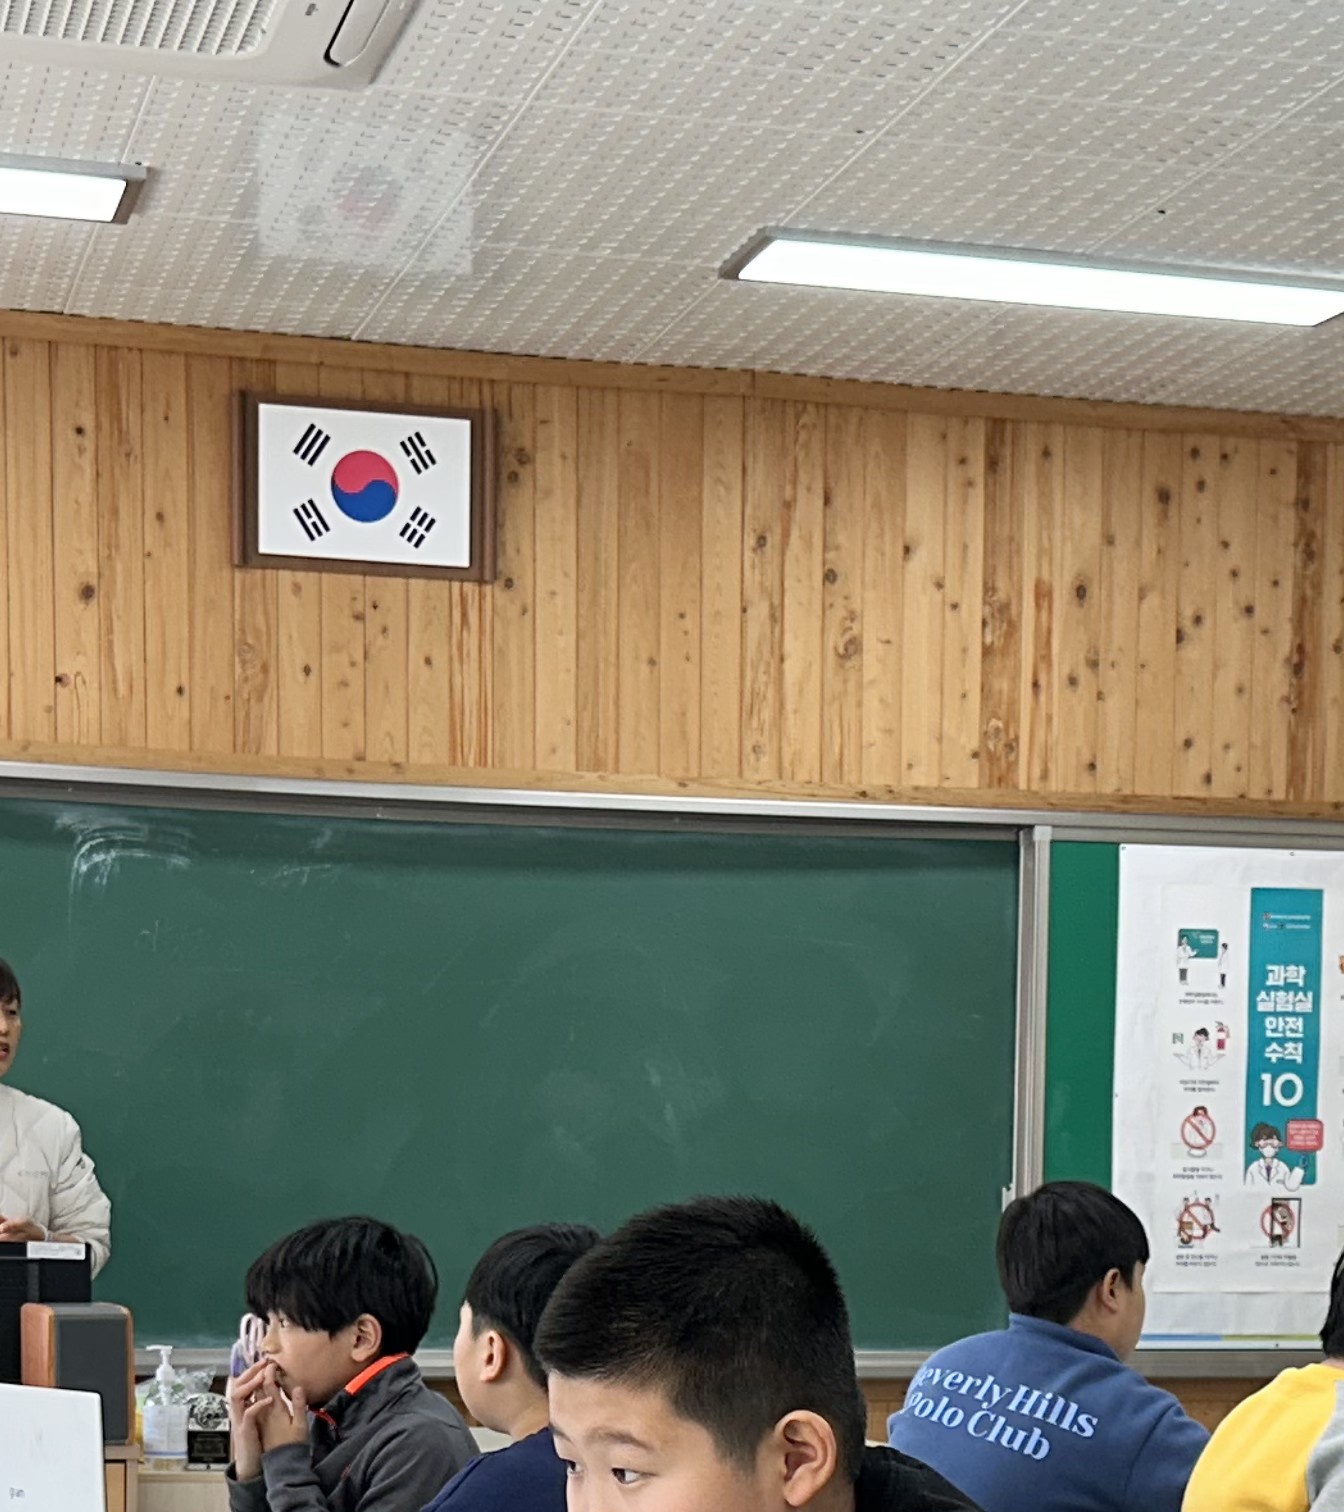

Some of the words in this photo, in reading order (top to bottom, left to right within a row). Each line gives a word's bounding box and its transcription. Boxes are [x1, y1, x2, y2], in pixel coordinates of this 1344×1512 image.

[1265, 963, 1305, 988] 과학
[1255, 990, 1314, 1014] 실험실
[1264, 1016, 1304, 1039] 안전
[1264, 1041, 1303, 1064] 수칙
[1260, 1072, 1303, 1107] 10
[917, 1365, 1012, 1409] everly
[1007, 1385, 1098, 1438] Hills
[967, 1410, 1051, 1461] Club
